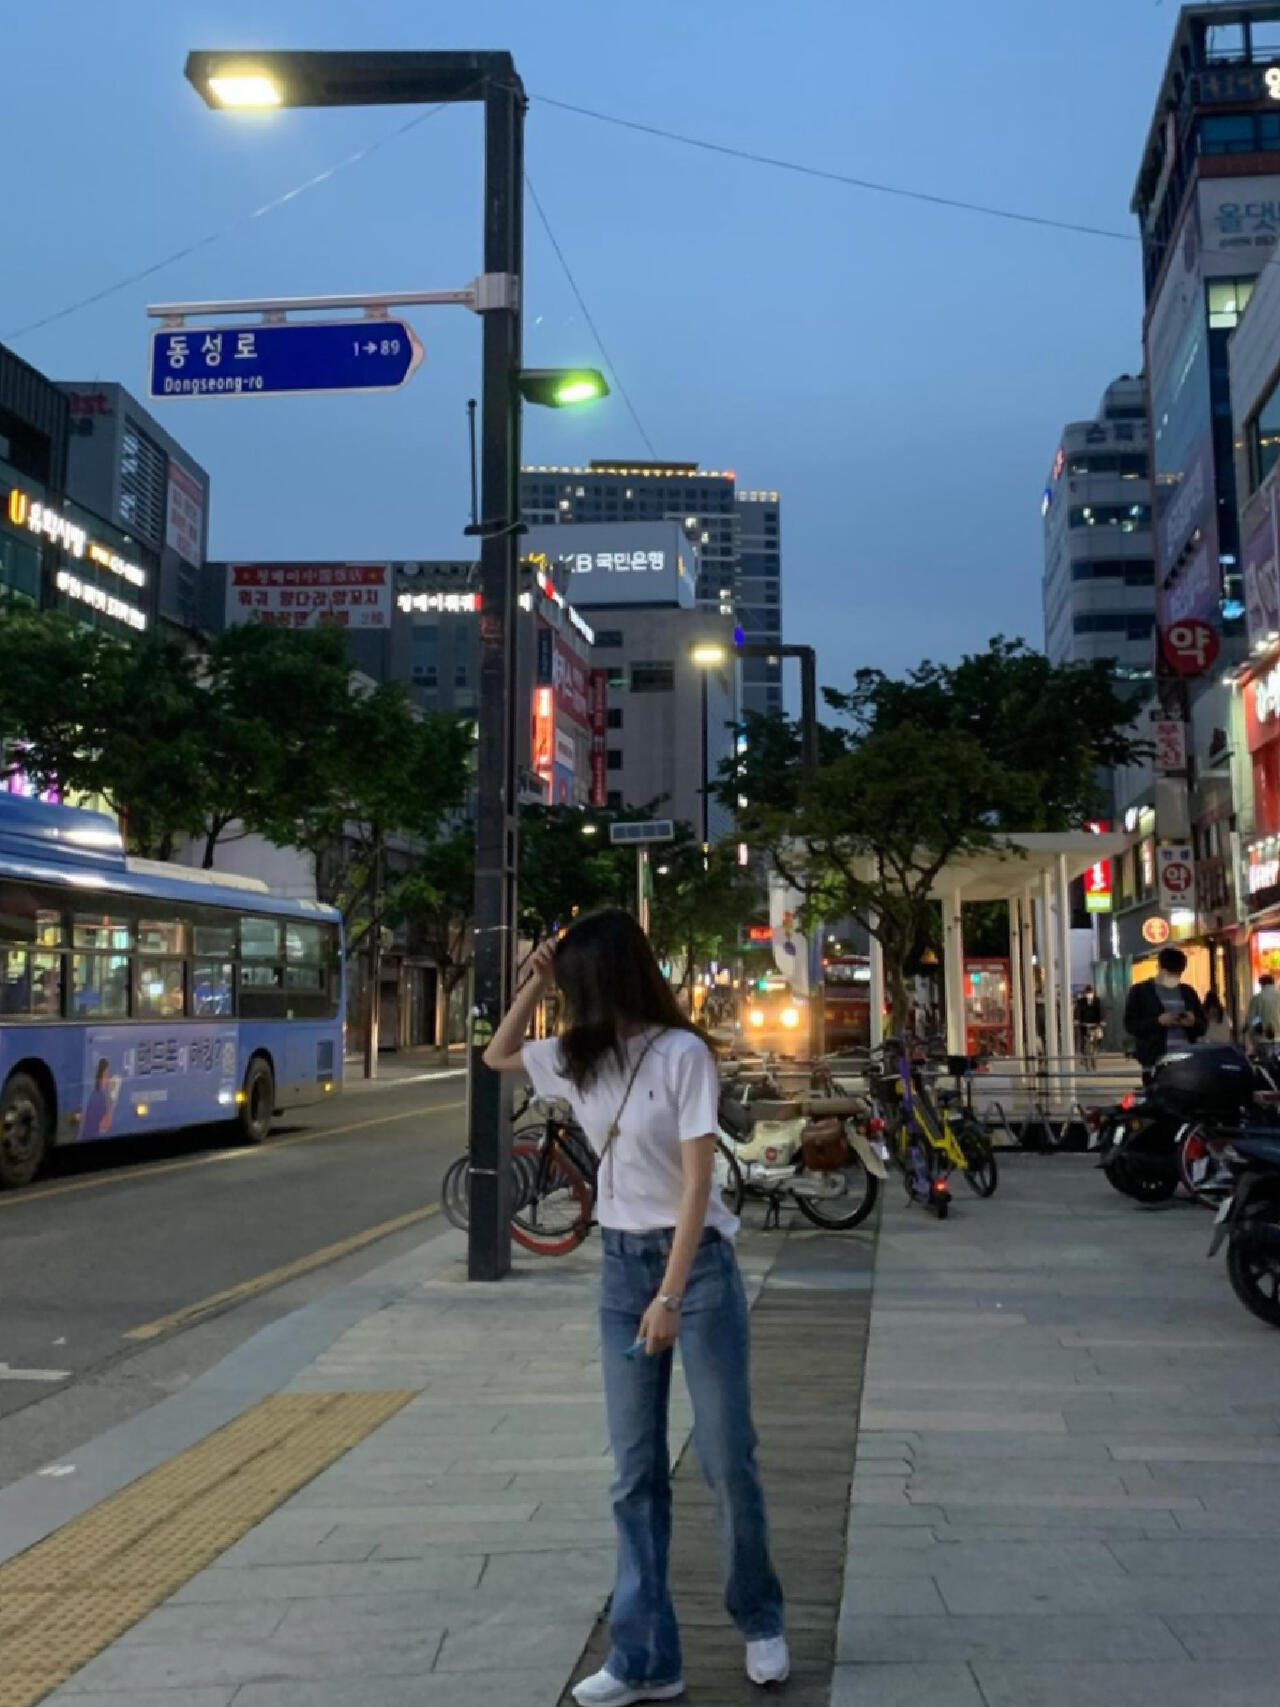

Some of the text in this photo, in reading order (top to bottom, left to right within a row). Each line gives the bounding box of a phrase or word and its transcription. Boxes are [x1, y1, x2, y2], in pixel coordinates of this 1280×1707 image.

[1215, 201, 1280, 234] 올댓
[166, 334, 258, 368] 동성로
[380, 340, 400, 355] 89
[163, 375, 263, 394] Dongseong-ro
[596, 551, 665, 571] 국민은행
[1169, 627, 1210, 665] 약
[1166, 868, 1187, 889] 약
